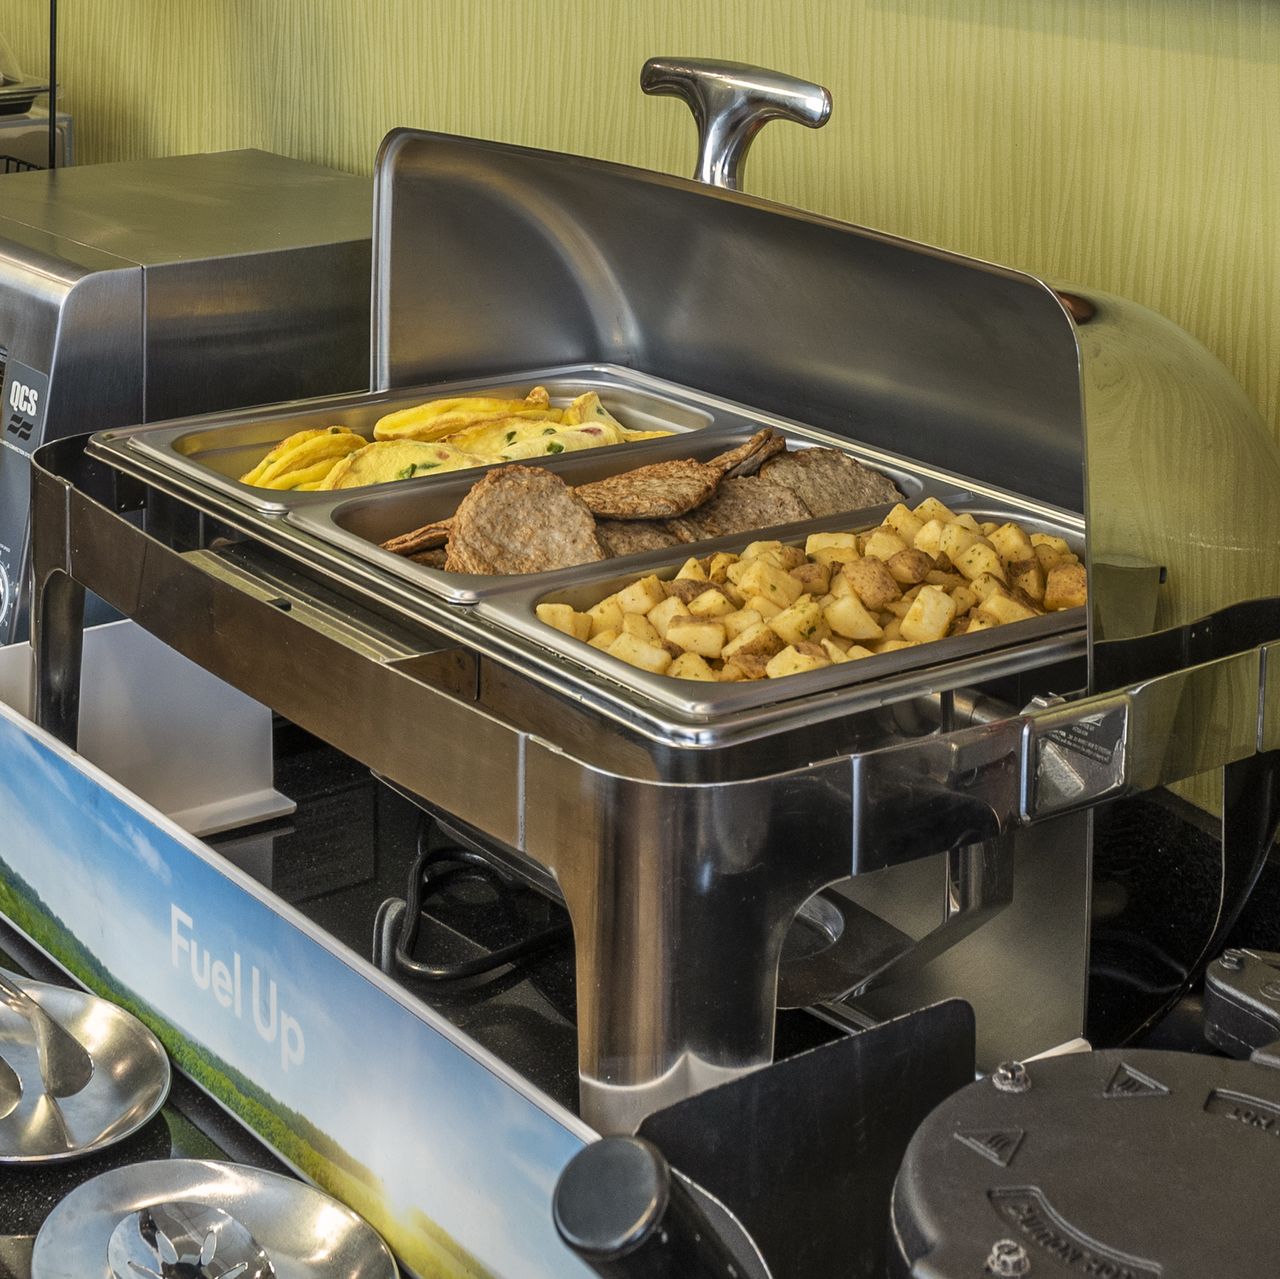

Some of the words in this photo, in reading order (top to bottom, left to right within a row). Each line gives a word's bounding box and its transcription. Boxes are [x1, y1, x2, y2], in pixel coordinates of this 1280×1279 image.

[9, 380, 39, 417] QCS
[171, 903, 241, 1019] Fuel
[252, 966, 305, 1073] Up
